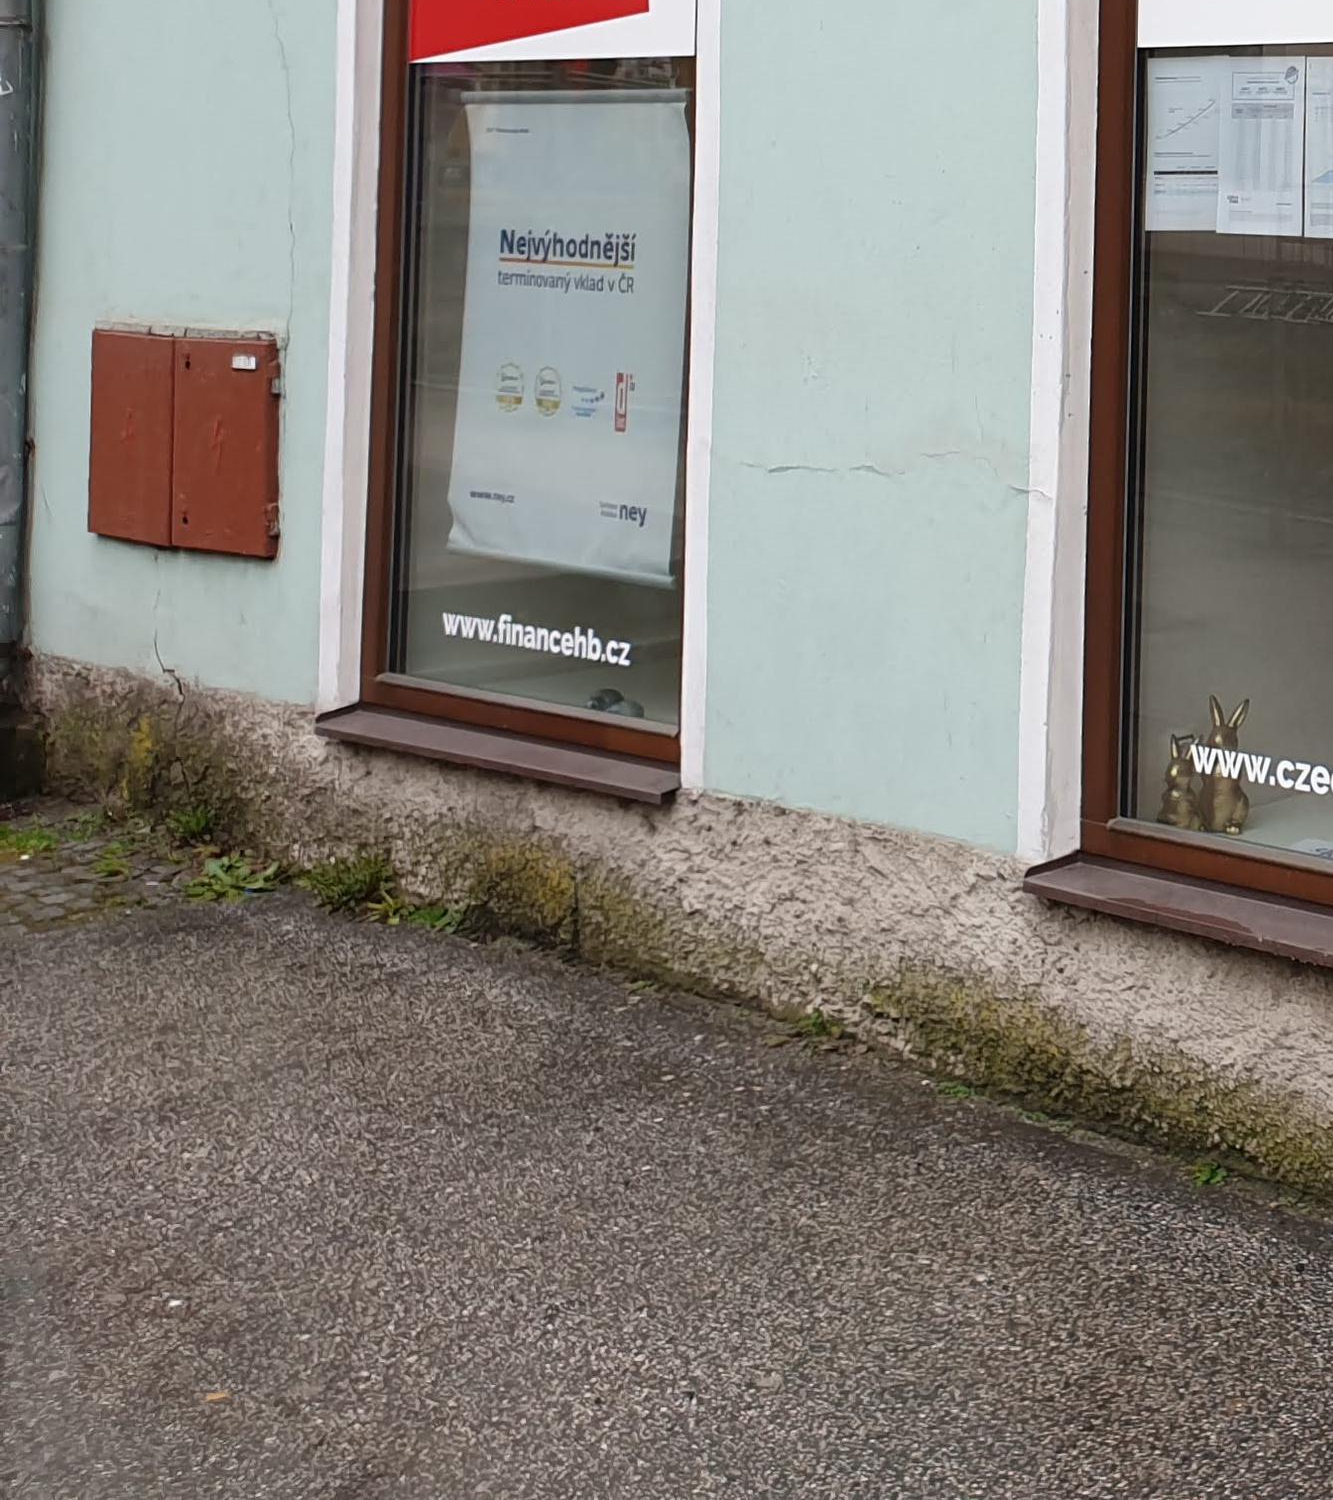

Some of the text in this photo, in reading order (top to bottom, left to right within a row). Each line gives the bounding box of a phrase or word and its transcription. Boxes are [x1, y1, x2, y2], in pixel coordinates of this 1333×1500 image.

[500, 229, 637, 267] Nejvýhodnější
[498, 270, 635, 294] termínovaný vklad v ČR
[619, 504, 648, 527] ney
[442, 611, 632, 667] www.financehb.cz
